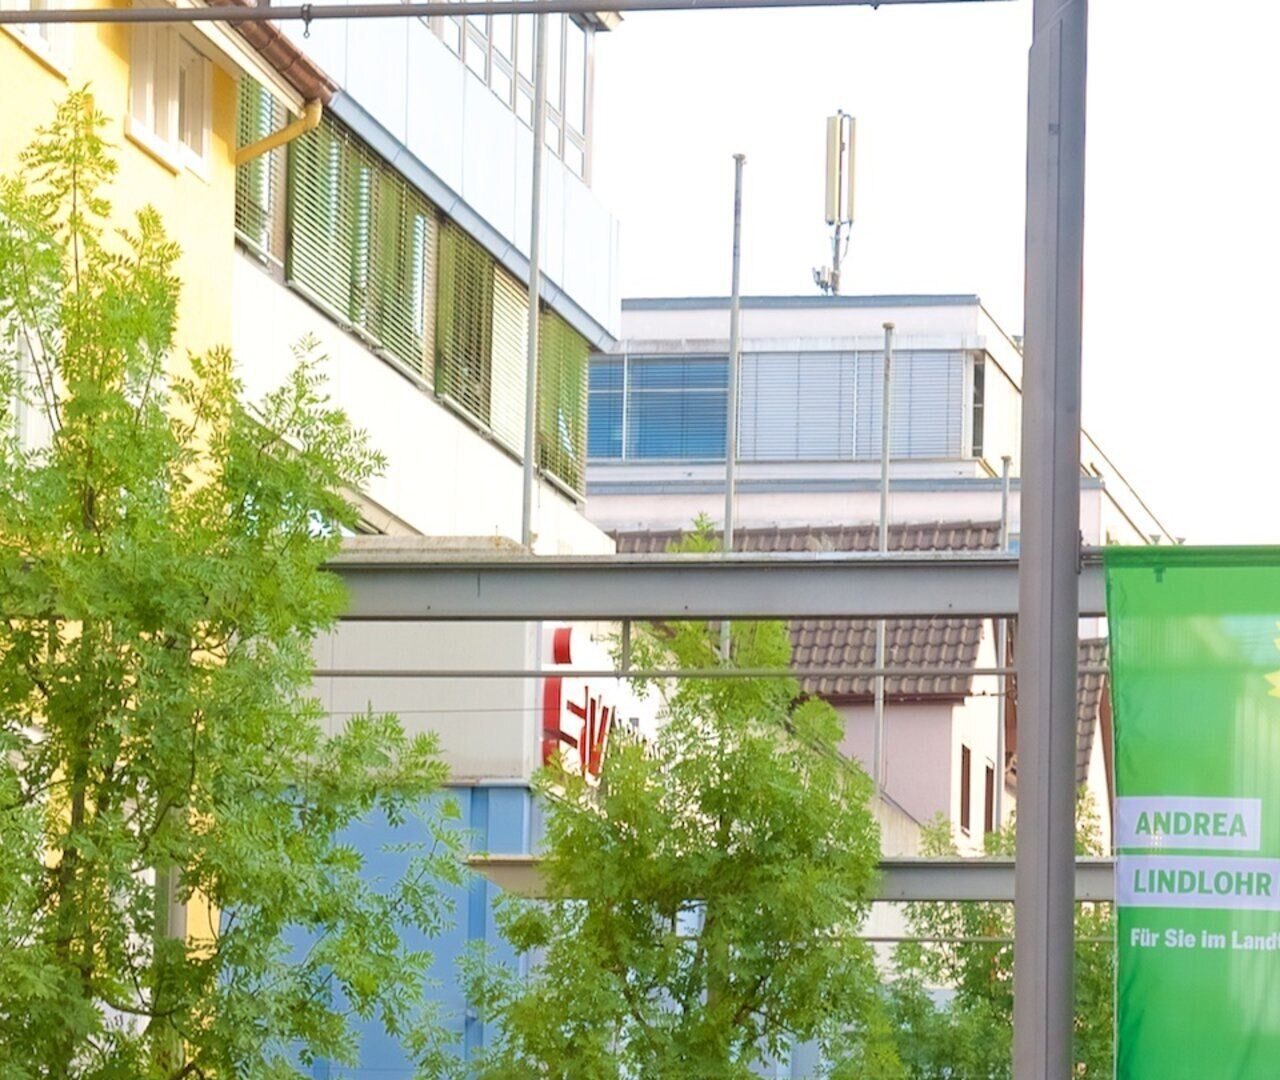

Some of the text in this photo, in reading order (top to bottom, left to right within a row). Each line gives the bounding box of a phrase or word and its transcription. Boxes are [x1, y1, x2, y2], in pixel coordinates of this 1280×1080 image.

[1135, 811, 1247, 838] ANDREA
[1133, 869, 1272, 897] LINDLOHR
[1130, 928, 1160, 948] Für
[1164, 929, 1196, 949] Sie
[1201, 931, 1226, 949] im
